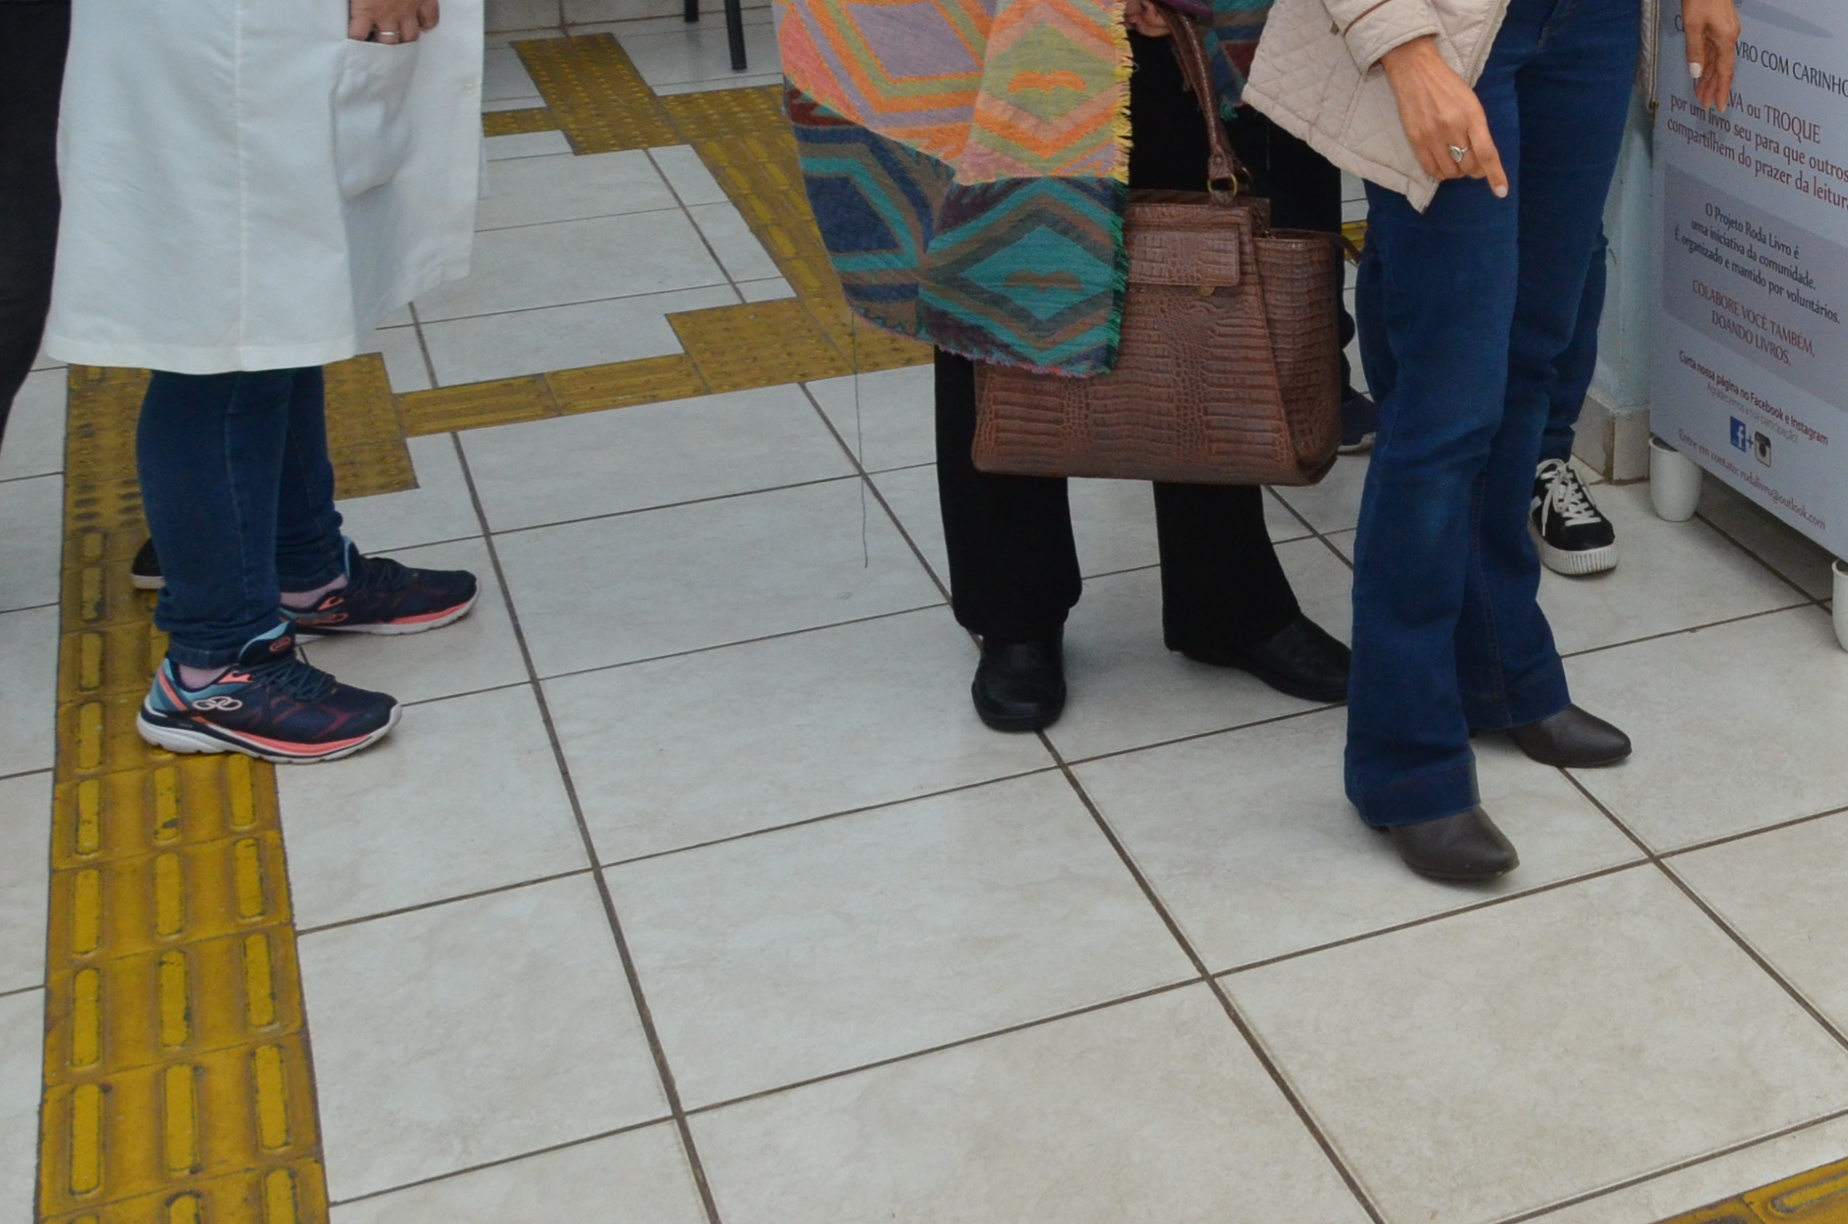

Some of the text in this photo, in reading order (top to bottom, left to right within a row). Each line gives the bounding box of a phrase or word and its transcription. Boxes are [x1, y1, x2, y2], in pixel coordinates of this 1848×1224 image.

[1760, 50, 1789, 76] COM
[1667, 118, 1735, 161] compartilhem
[1738, 146, 1752, 168] do
[1754, 159, 1793, 186] prazer
[1794, 171, 1810, 194] da
[1670, 94, 1687, 112] por
[1689, 102, 1706, 122] um
[1708, 108, 1731, 133] livro
[1733, 124, 1752, 142] seu
[1755, 132, 1780, 155] para
[1783, 144, 1805, 166] que
[1747, 103, 1821, 145] ou TROQUE
[1691, 220, 1817, 291] uma iniciativa da comunidade.
[1705, 202, 1800, 260] O Projeto Roda Livro é
[1681, 235, 1723, 266] organizado
[1731, 259, 1767, 288] mantido
[1768, 278, 1785, 299] por
[1786, 287, 1841, 325] voluntários.
[1692, 279, 1815, 358] COLABORE VOCÊ TAMBÉM,
[1711, 309, 1792, 366] DOANDO LIVROS.
[1715, 372, 1740, 396] página
[1740, 387, 1750, 401] no
[1750, 391, 1785, 422] Facebook
[1790, 411, 1829, 446] Instagram
